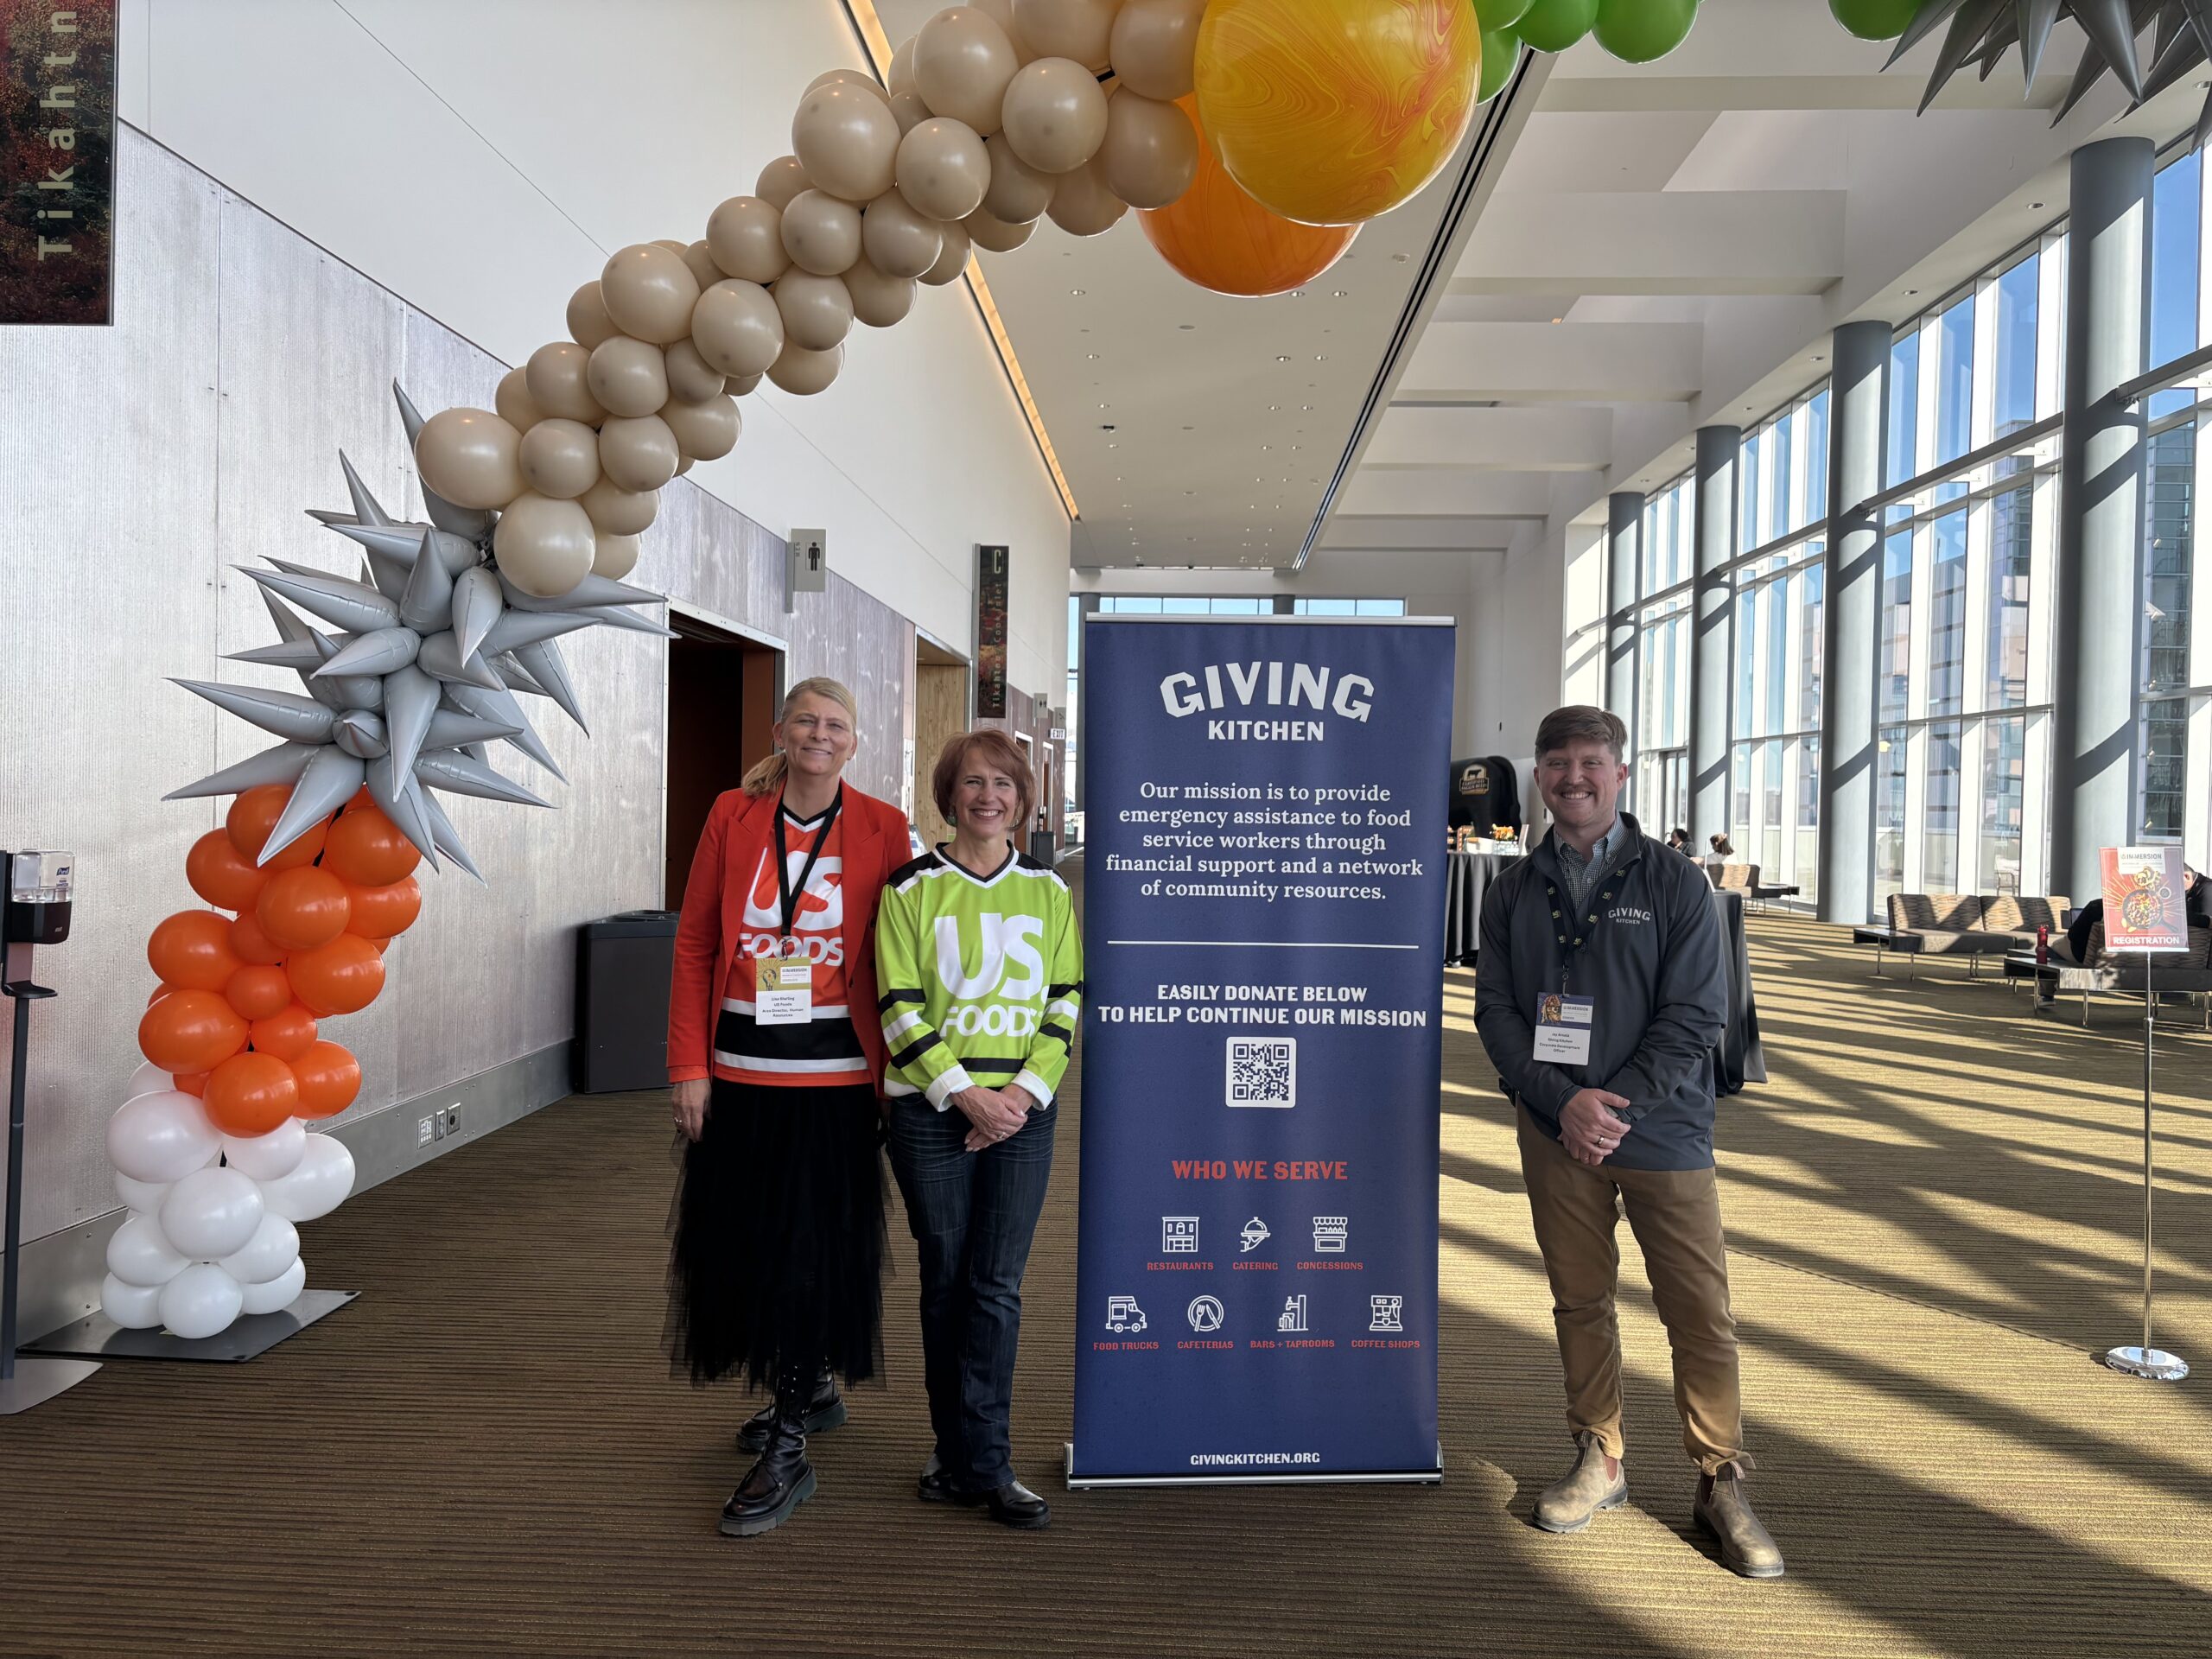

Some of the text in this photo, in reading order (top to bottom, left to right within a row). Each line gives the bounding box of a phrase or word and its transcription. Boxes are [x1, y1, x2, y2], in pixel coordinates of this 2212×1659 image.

[1160, 661, 1375, 723] GIVING
[1052, 729, 1064, 738] EXIT
[1208, 720, 1324, 741] KITCHEN
[1140, 781, 1391, 806] Our mission is to provide
[1119, 807, 1412, 829] emergency assistance to food
[1142, 831, 1387, 856] service workers through
[1105, 854, 1423, 878] financial support and a network
[1141, 879, 1386, 903] of community resources.
[1608, 907, 1651, 922] GIVING
[2113, 936, 2180, 944] REGISTRATION
[1157, 984, 1368, 1002] EASILY DONATE BELOW
[1097, 1006, 1427, 1027] TO HELP CONTINUE OUR MISSION
[1172, 1160, 1348, 1181] WHO WE SERVE
[1147, 1262, 1214, 1271] RESTAURANTS
[1231, 1261, 1279, 1271] CATERING
[1295, 1261, 1363, 1271] CONCESSIONS
[1093, 1341, 1160, 1351] FOOD TRUCKS
[1176, 1340, 1235, 1350] CAFETERIAS
[1249, 1340, 1276, 1349] BARS
[1285, 1339, 1335, 1349] TAPROOMS
[1351, 1339, 1421, 1350] COFFEE SHOPS
[1190, 1452, 1320, 1465] GIVINGKITCHEN.ORG
